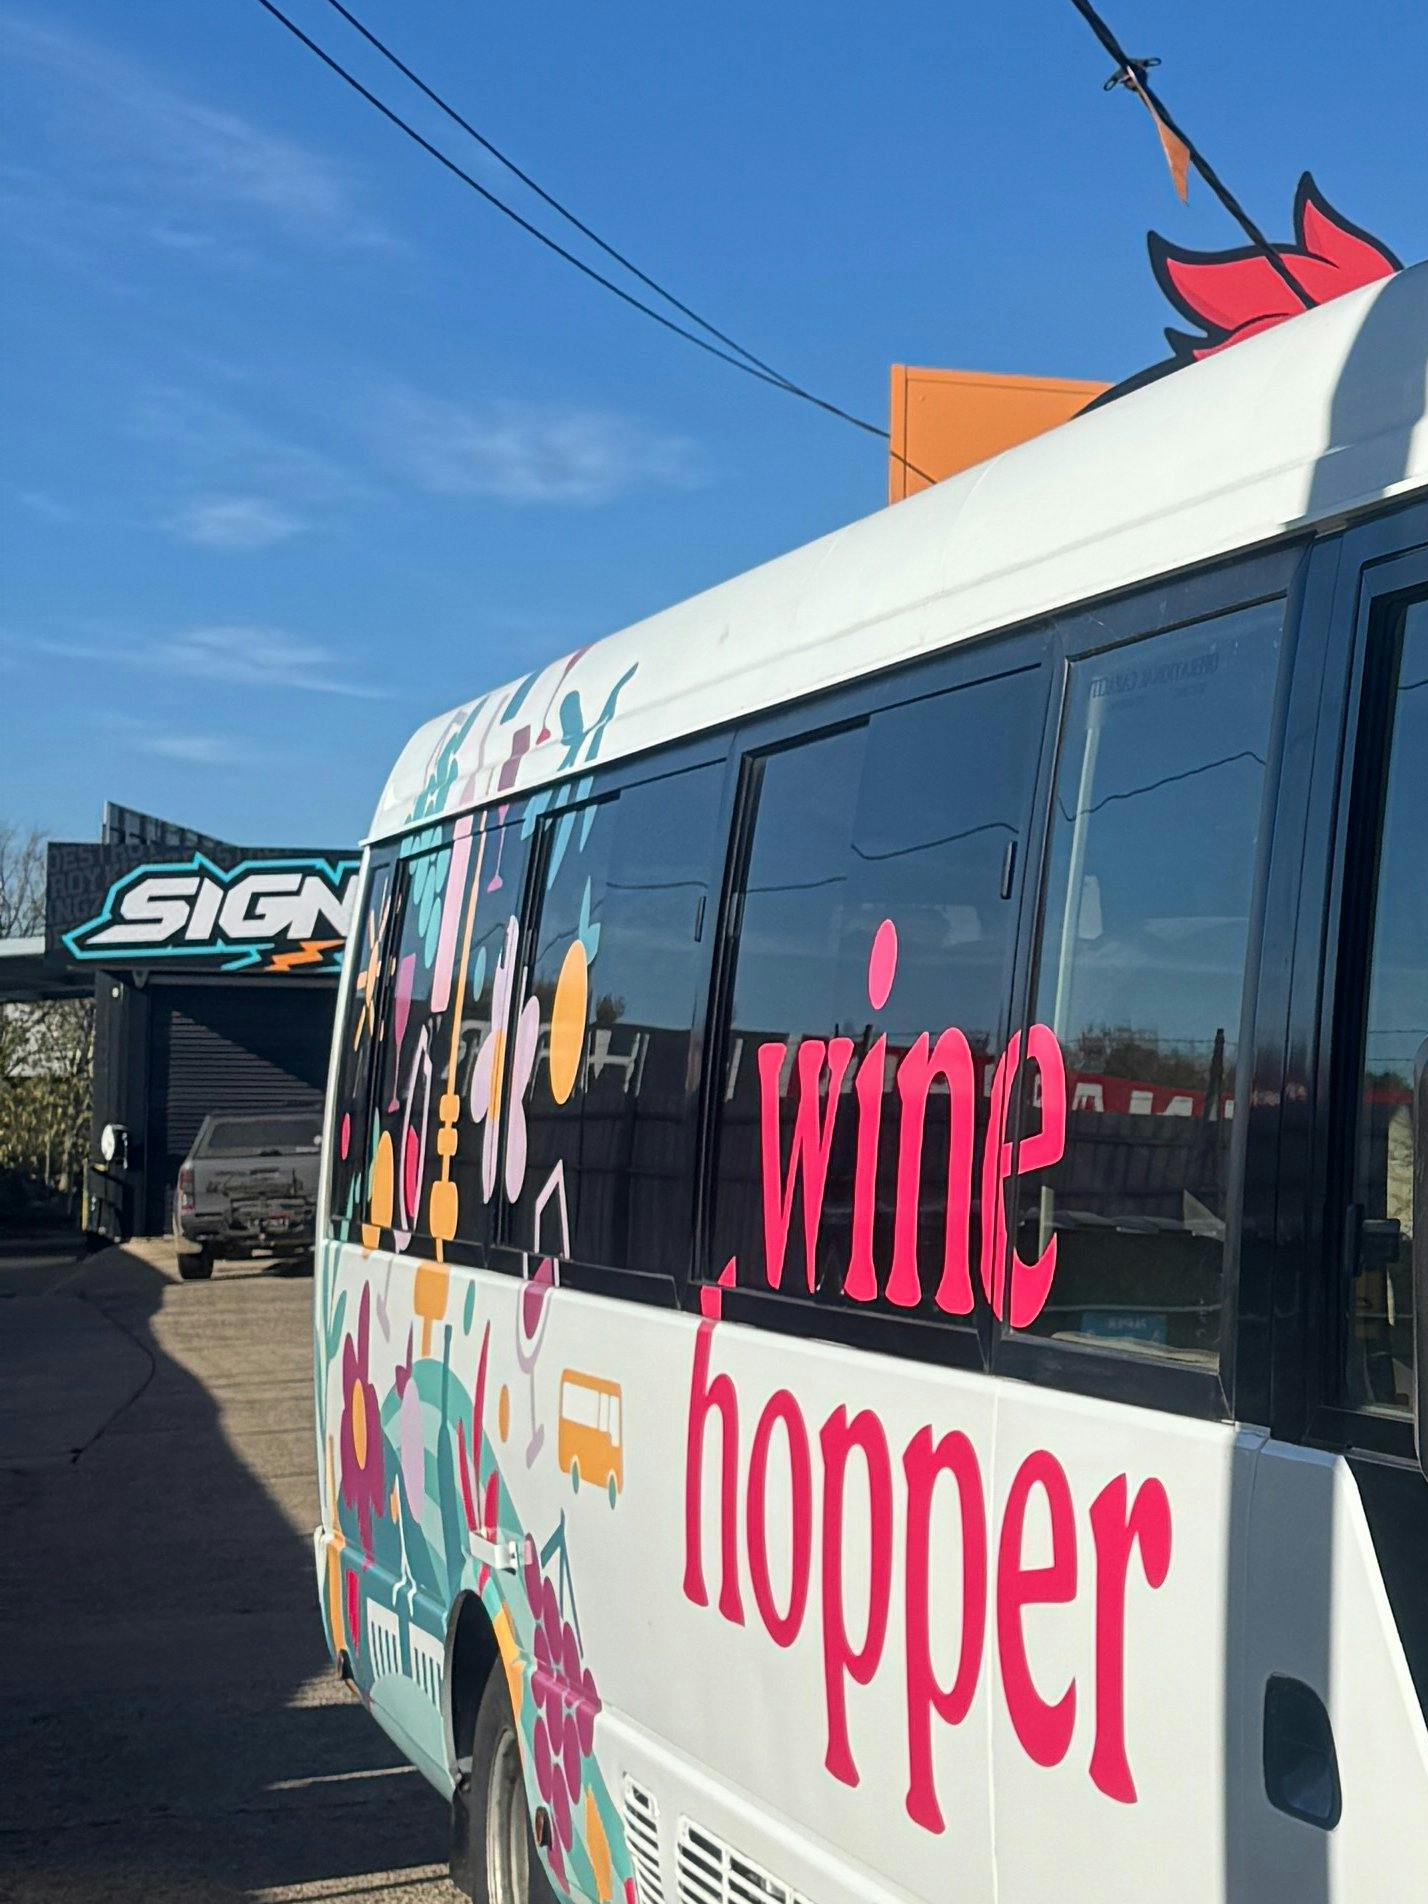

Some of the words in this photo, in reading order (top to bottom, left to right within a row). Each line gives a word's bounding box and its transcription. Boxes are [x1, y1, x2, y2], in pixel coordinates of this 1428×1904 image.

[85, 873, 358, 945] SIGN
[757, 918, 1067, 1330] wine
[683, 1256, 1172, 1834] hopper
